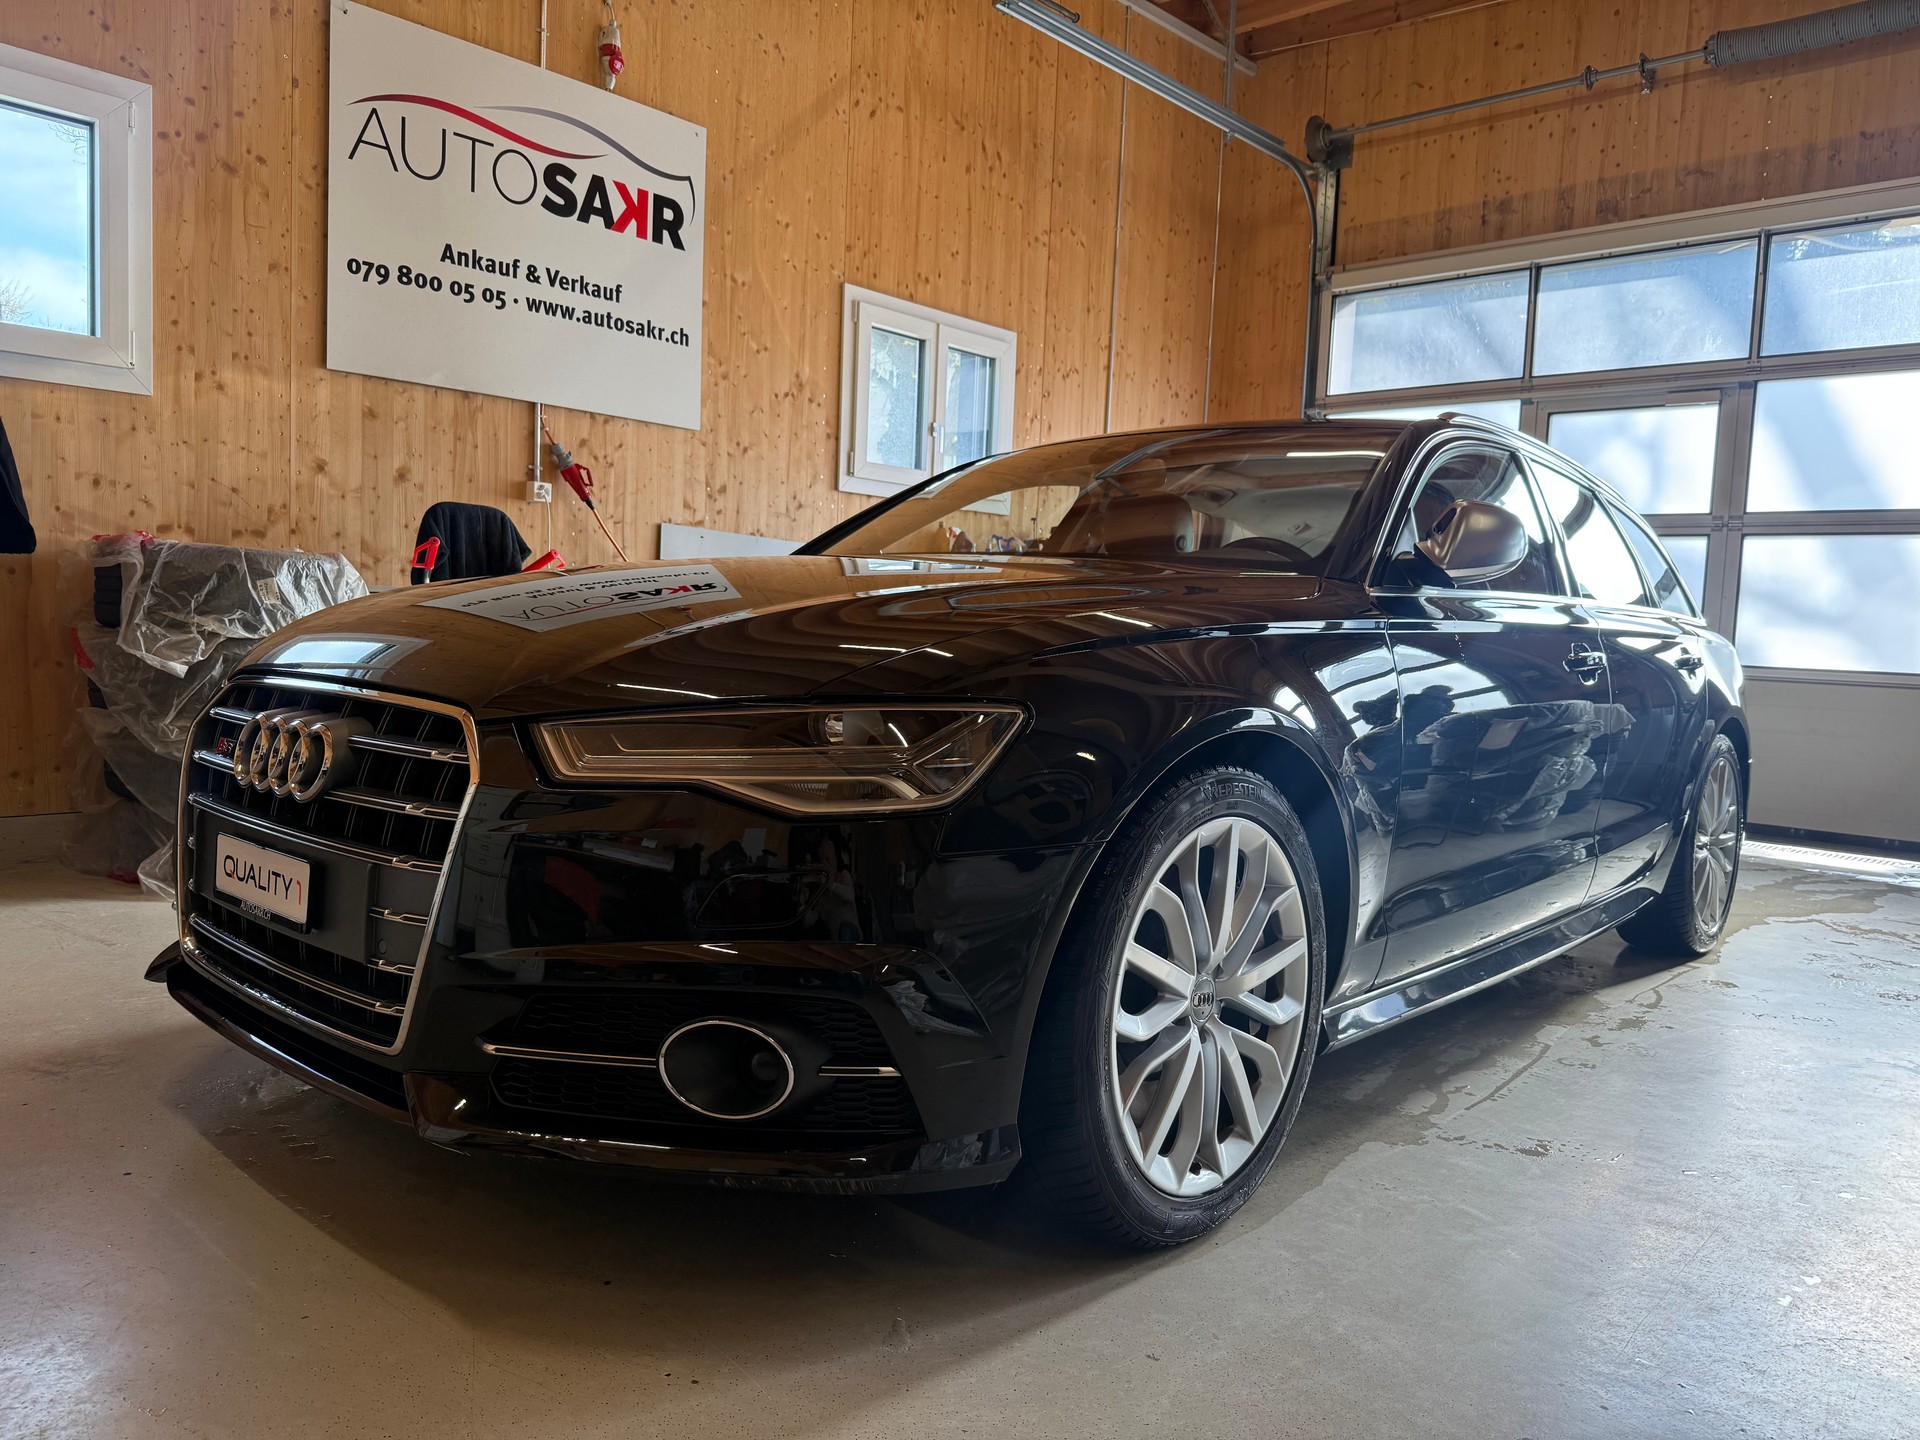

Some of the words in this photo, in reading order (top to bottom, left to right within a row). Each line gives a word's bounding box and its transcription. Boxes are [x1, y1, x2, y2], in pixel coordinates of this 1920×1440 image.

[347, 107, 686, 252] AUTOSAKR
[346, 257, 391, 286] 079
[396, 264, 443, 293] 800
[449, 280, 476, 304] 05
[481, 287, 507, 310] 05
[525, 296, 690, 348] www.autosakr.ch
[440, 243, 520, 280] Ankauf
[525, 264, 542, 285] &
[545, 267, 623, 304] Verkauf
[223, 854, 293, 900] QUALITY
